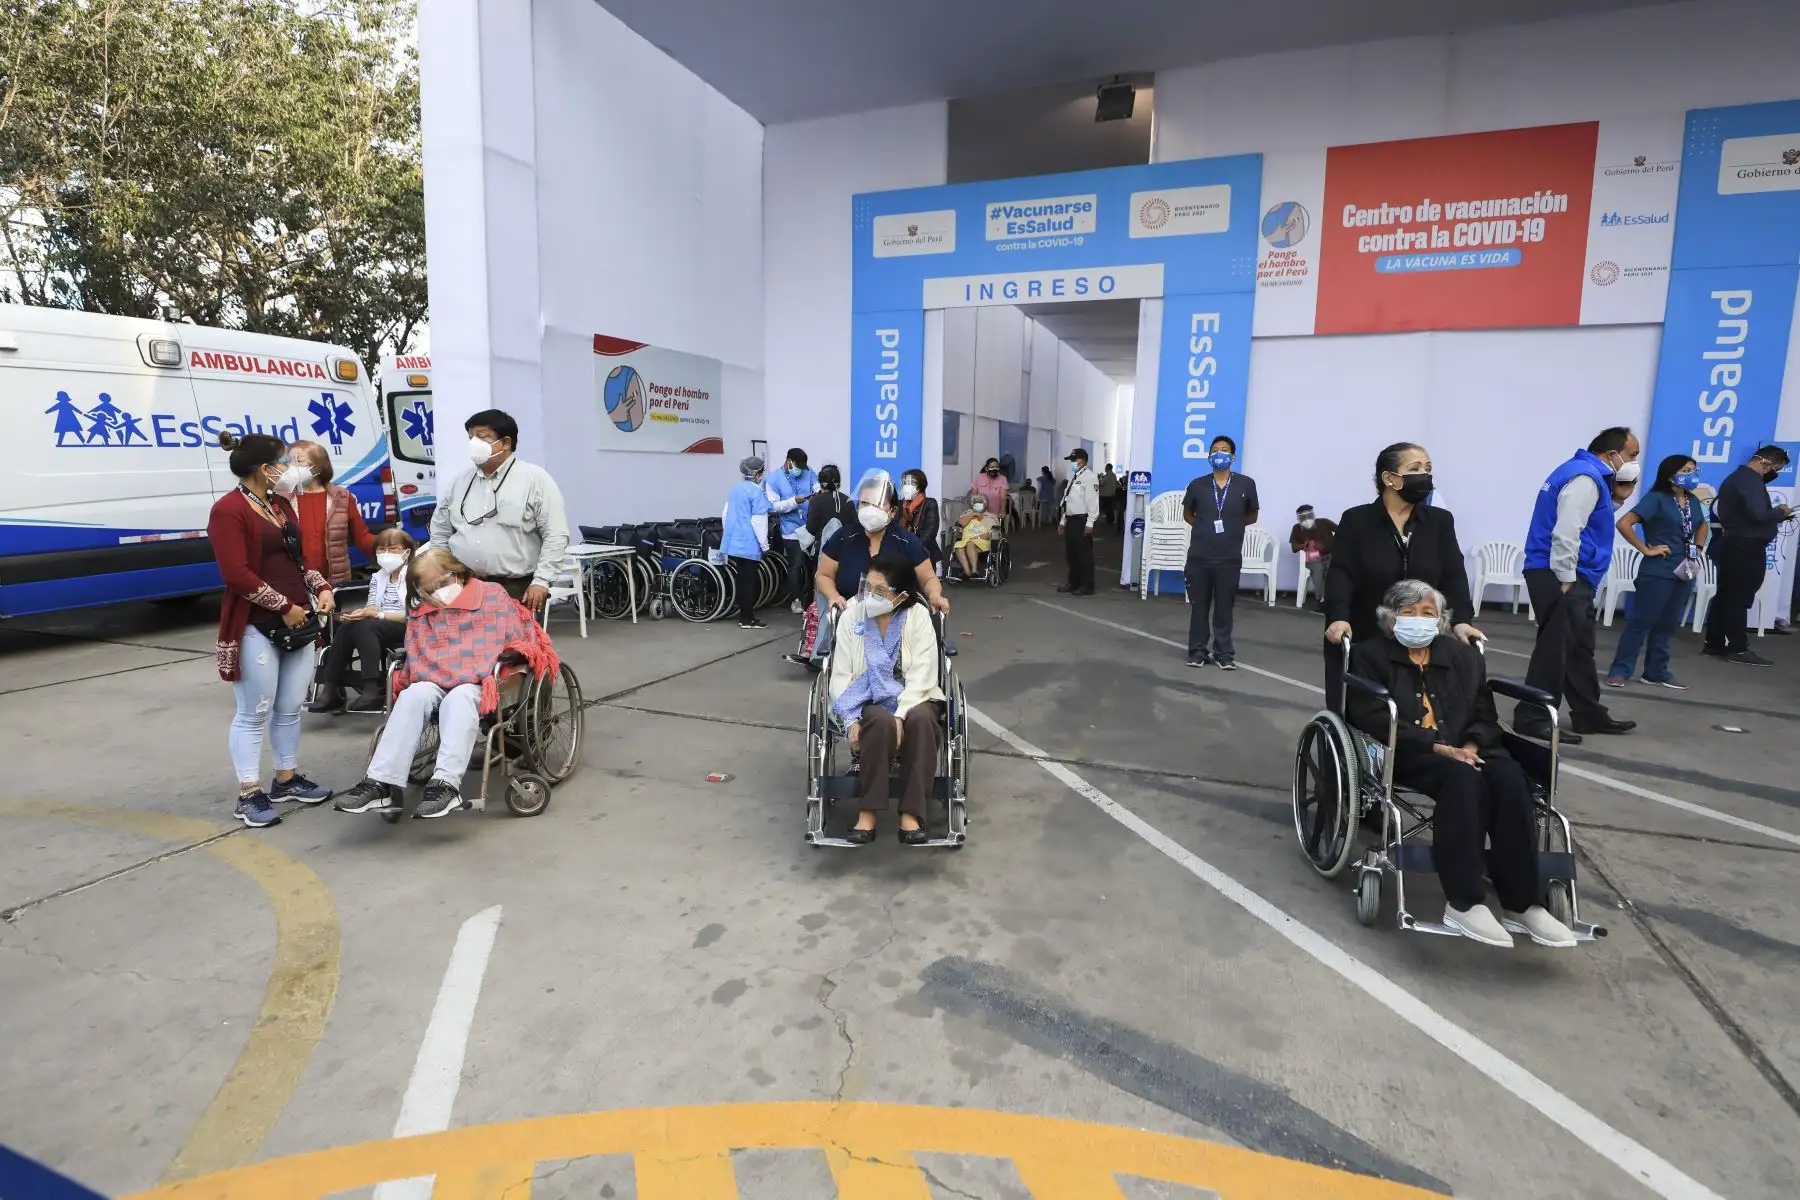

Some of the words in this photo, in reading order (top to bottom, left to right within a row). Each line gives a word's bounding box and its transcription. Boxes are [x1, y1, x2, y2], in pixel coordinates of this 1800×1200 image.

[1604, 168, 1640, 177] Gobierno
[1642, 165, 1654, 173] del
[1656, 164, 1674, 173] Perú
[1737, 167, 1791, 179] Gobierno
[990, 201, 1093, 220] #Vacunarse
[1174, 203, 1220, 212] BICENTENARIO
[1342, 202, 1413, 228] Centro
[1416, 198, 1442, 222] de
[1444, 190, 1568, 222] vacunación
[1006, 216, 1074, 235] EsSalud
[1624, 212, 1670, 226] EsSalud
[883, 238, 914, 247] Gobierno
[915, 235, 926, 244] del
[1358, 228, 1428, 253] contra
[1430, 225, 1450, 249] la
[1453, 217, 1546, 247] COVID-19
[996, 241, 1027, 252] contra
[1028, 239, 1037, 250] la
[1038, 236, 1084, 249] COVID-19
[1268, 250, 1298, 260] Pongo
[1385, 258, 1401, 270] LA
[1405, 255, 1458, 269] VACUNA
[1461, 254, 1476, 265] ES
[1479, 252, 1510, 264] VIDA
[1258, 260, 1267, 269] el
[1269, 259, 1306, 268] hombro
[1256, 271, 1274, 280] por
[1275, 268, 1284, 277] el
[1285, 267, 1308, 277] Perú
[964, 275, 1115, 301] INGRESO
[191, 351, 327, 380] AMBULANCIA
[396, 356, 432, 370] AMB
[1691, 289, 1753, 463] EsSalud
[649, 382, 673, 398] Pongo
[674, 385, 682, 397] el
[682, 386, 710, 401] hombro
[875, 328, 900, 459] EsSalud
[1182, 312, 1220, 459] EsSalud
[649, 398, 664, 410] por
[664, 398, 672, 409] el
[672, 399, 689, 411] Perú
